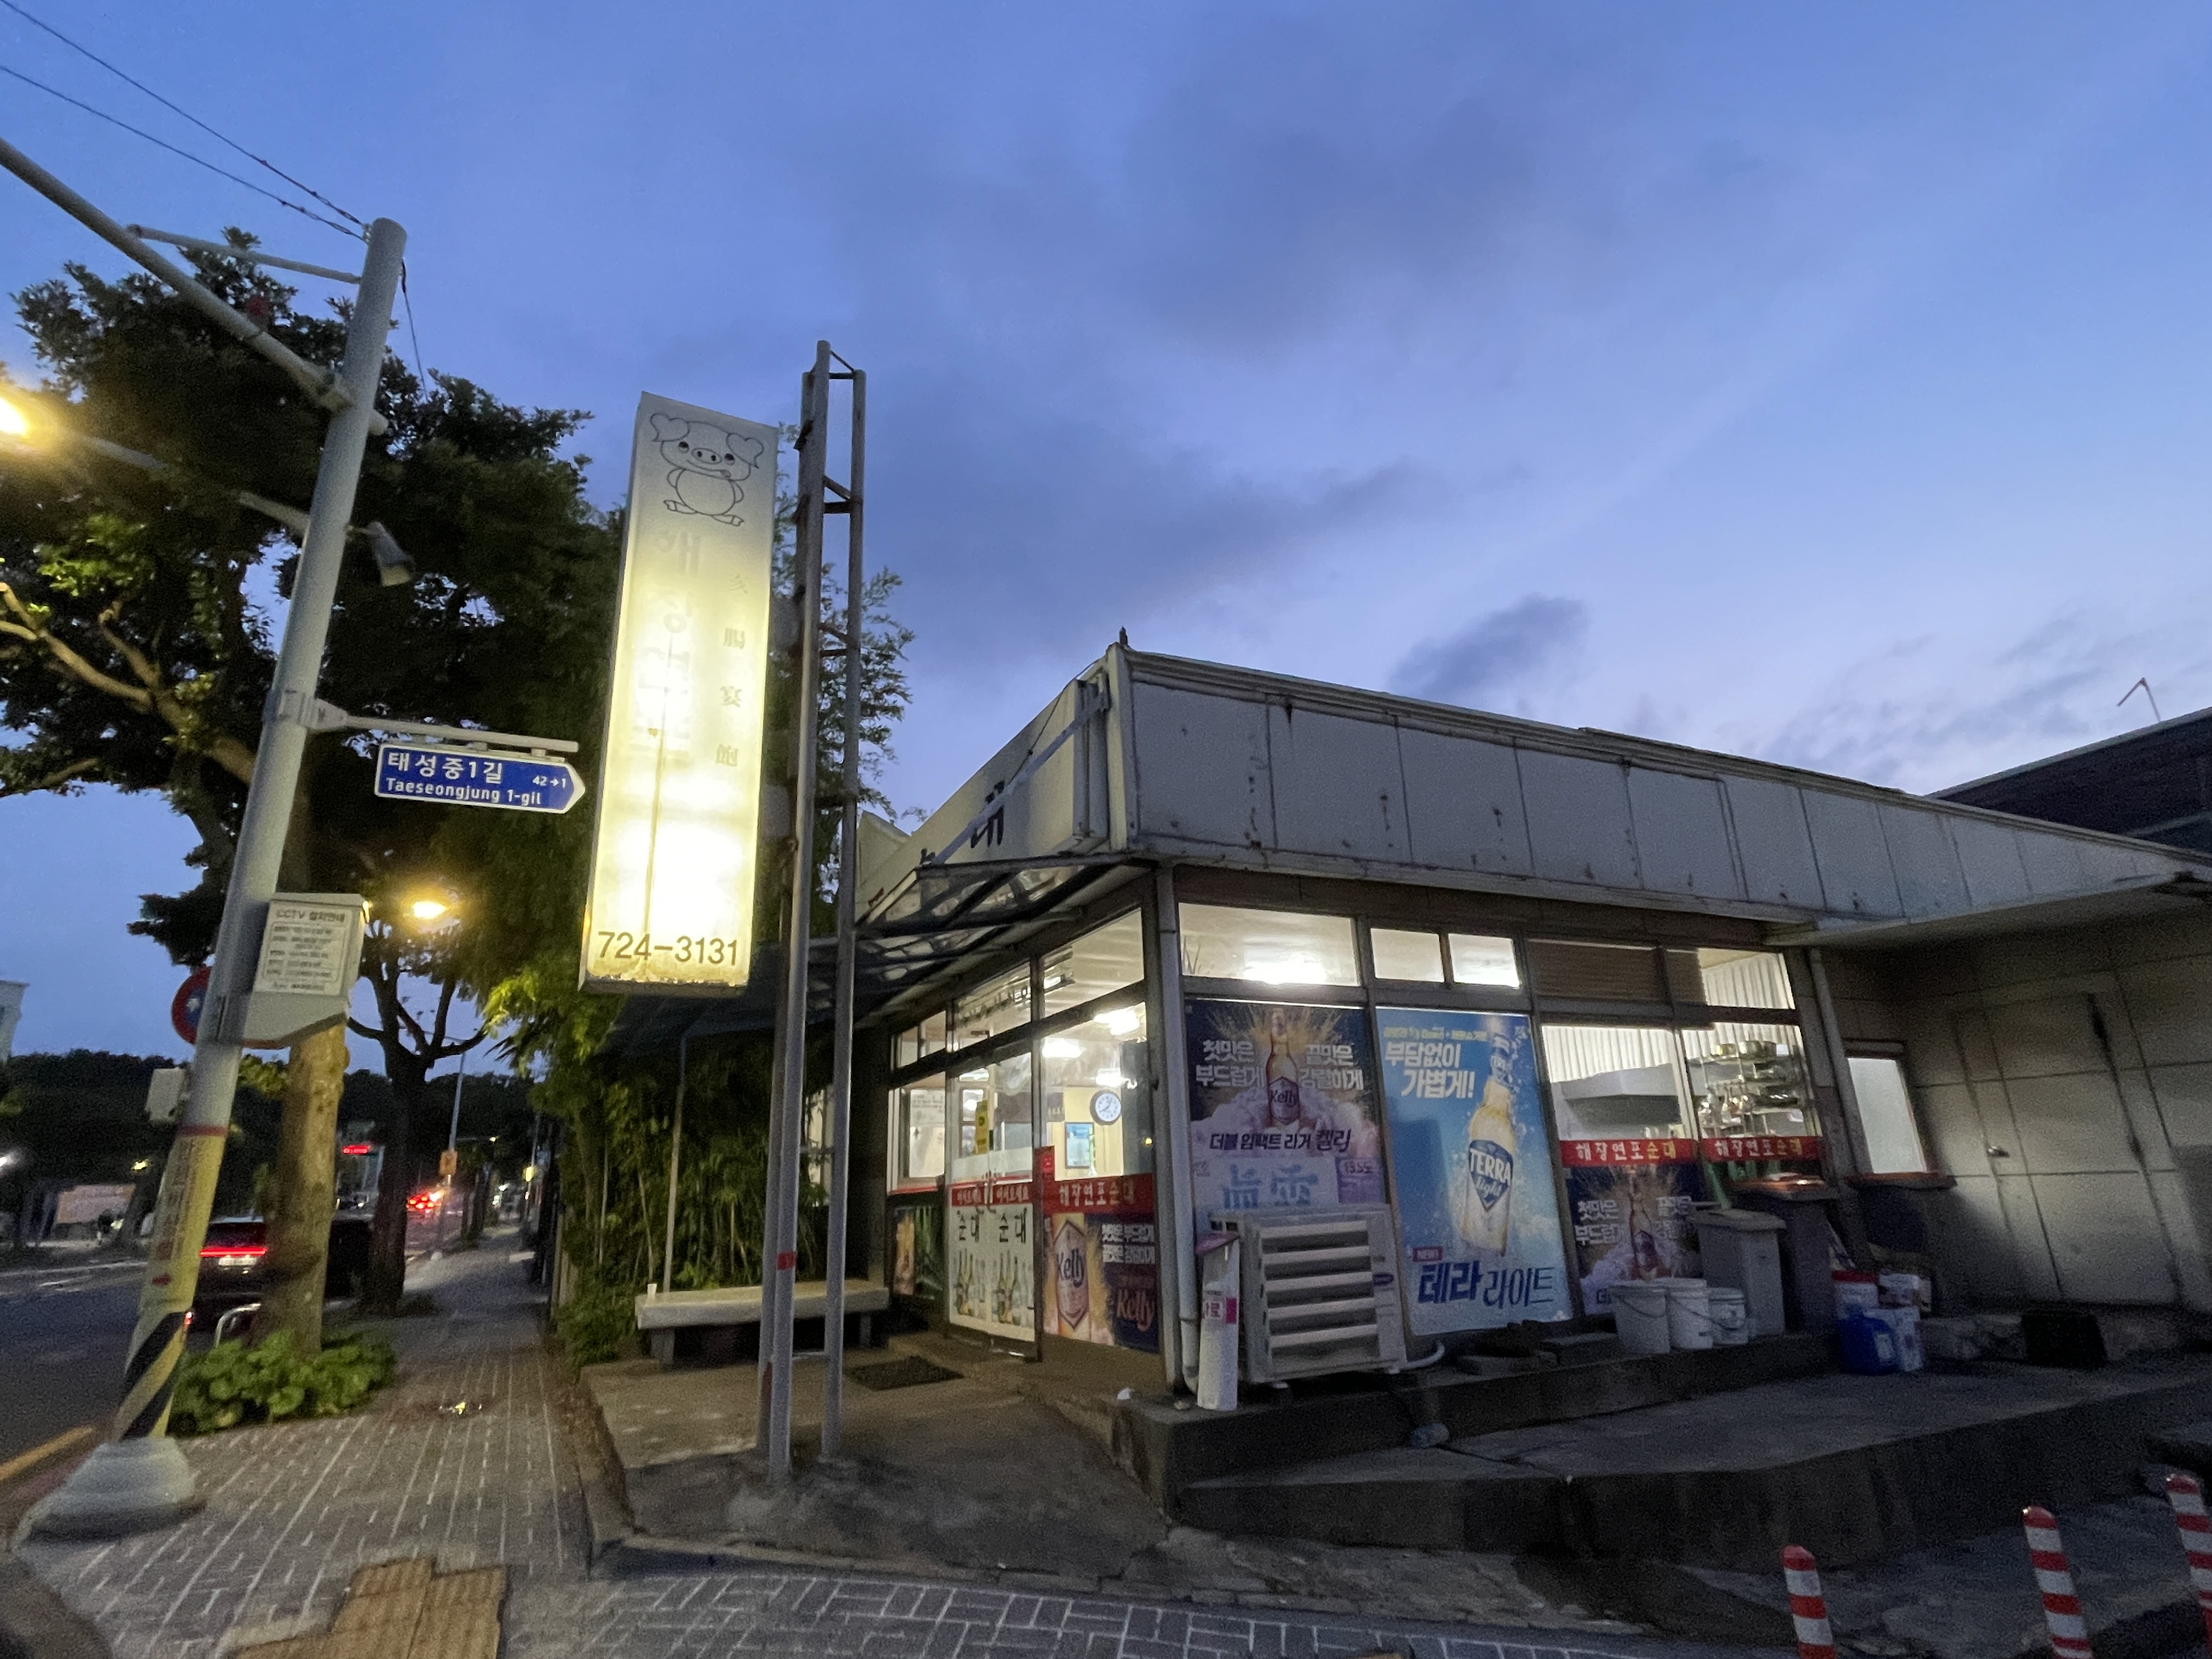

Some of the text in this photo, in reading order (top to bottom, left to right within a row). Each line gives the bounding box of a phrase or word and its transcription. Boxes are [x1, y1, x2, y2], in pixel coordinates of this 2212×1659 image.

[388, 752, 503, 784] 태성중1길
[532, 775, 548, 786] 42
[386, 777, 541, 806] Taeseongjung 1-gil
[276, 910, 306, 919] CCTV
[597, 931, 739, 966] 724-3131
[1203, 1040, 1254, 1062] 첫맛은
[1385, 1042, 1461, 1068] 부담없이
[1196, 1065, 1265, 1087] 부드럽게
[1297, 1068, 1364, 1091] 강렬하게
[1401, 1070, 1475, 1098] 가볍게!
[1210, 1133, 1238, 1150] 더블
[1317, 1128, 1351, 1152] 켈리
[1576, 1141, 1677, 1161] 해장연포순대
[1470, 1148, 1511, 1186] TERRA
[1418, 1260, 1555, 1309] 테라 라이트
[1116, 1289, 1154, 1332] Kelly
